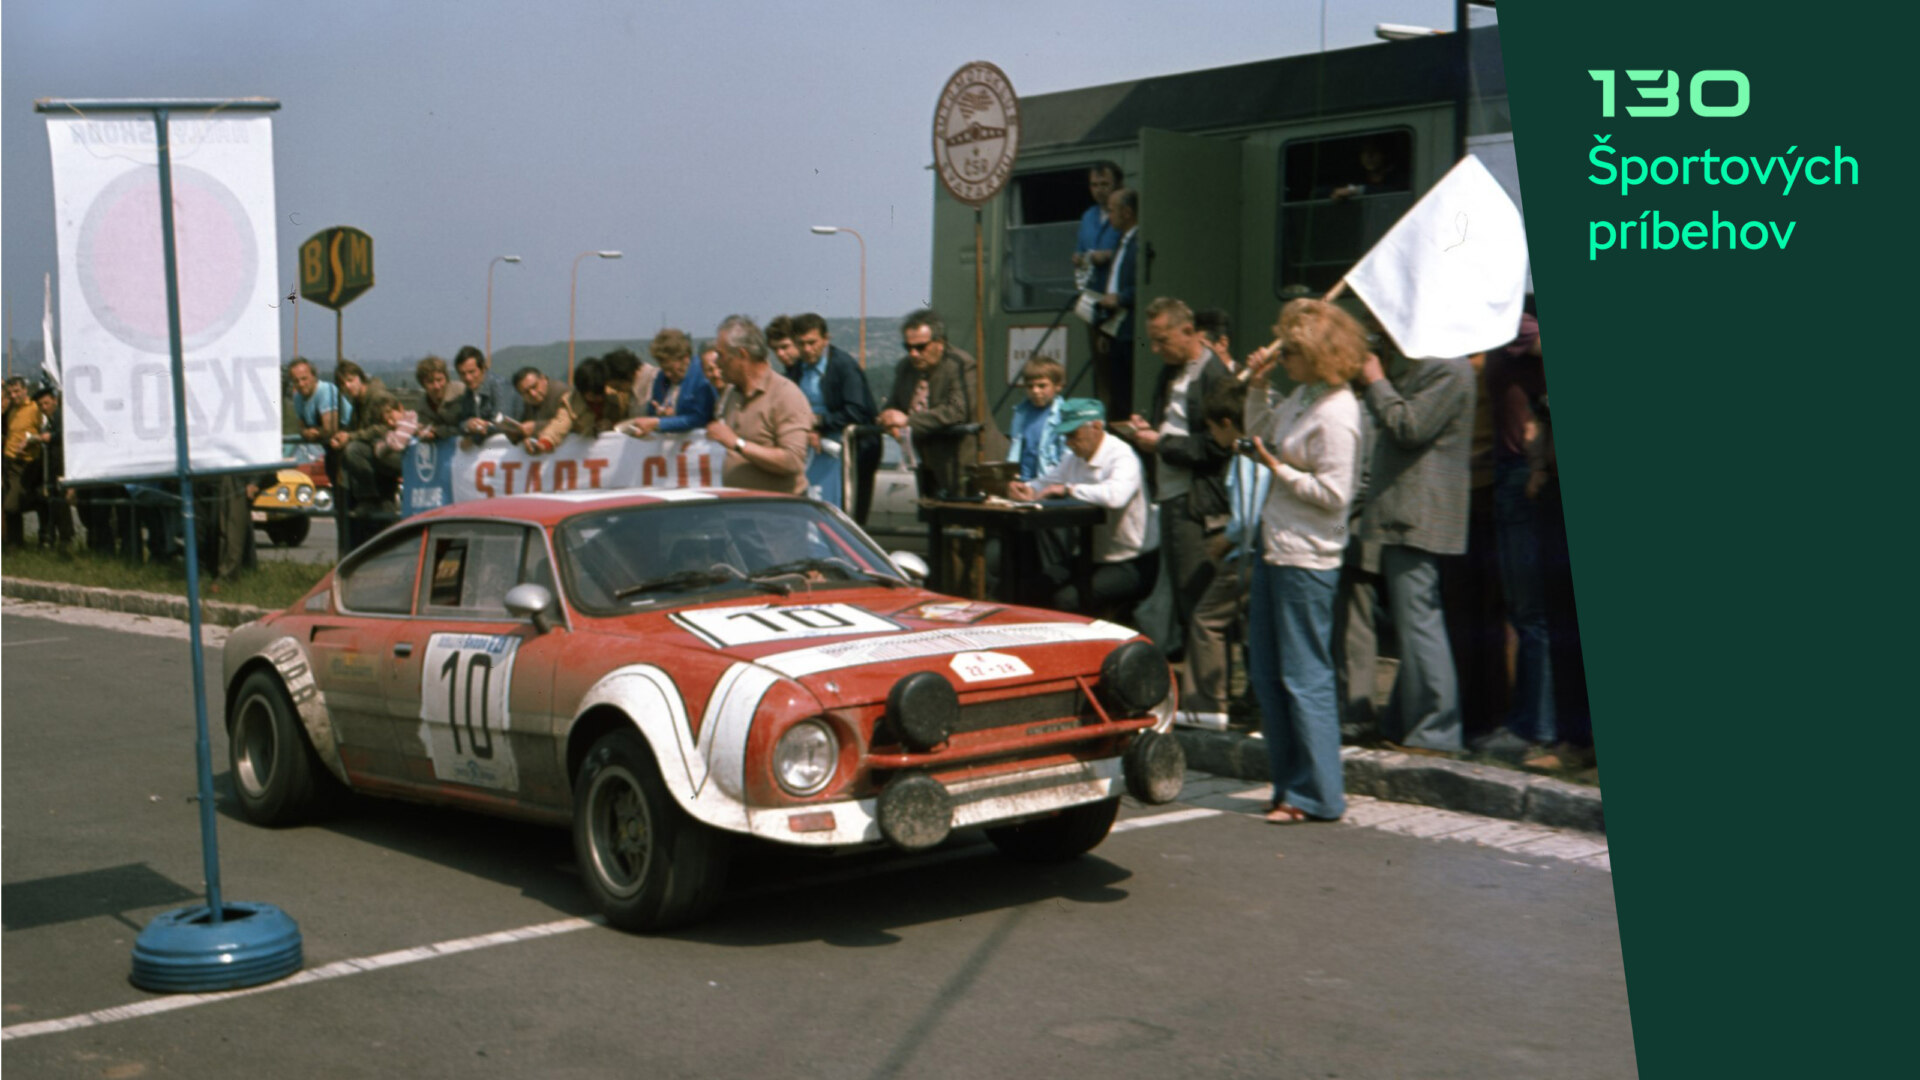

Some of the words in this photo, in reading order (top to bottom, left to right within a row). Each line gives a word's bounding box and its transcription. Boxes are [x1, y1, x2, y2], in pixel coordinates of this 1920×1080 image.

[304, 230, 368, 303] BSM
[725, 608, 855, 632] 10
[440, 650, 494, 760] 10
